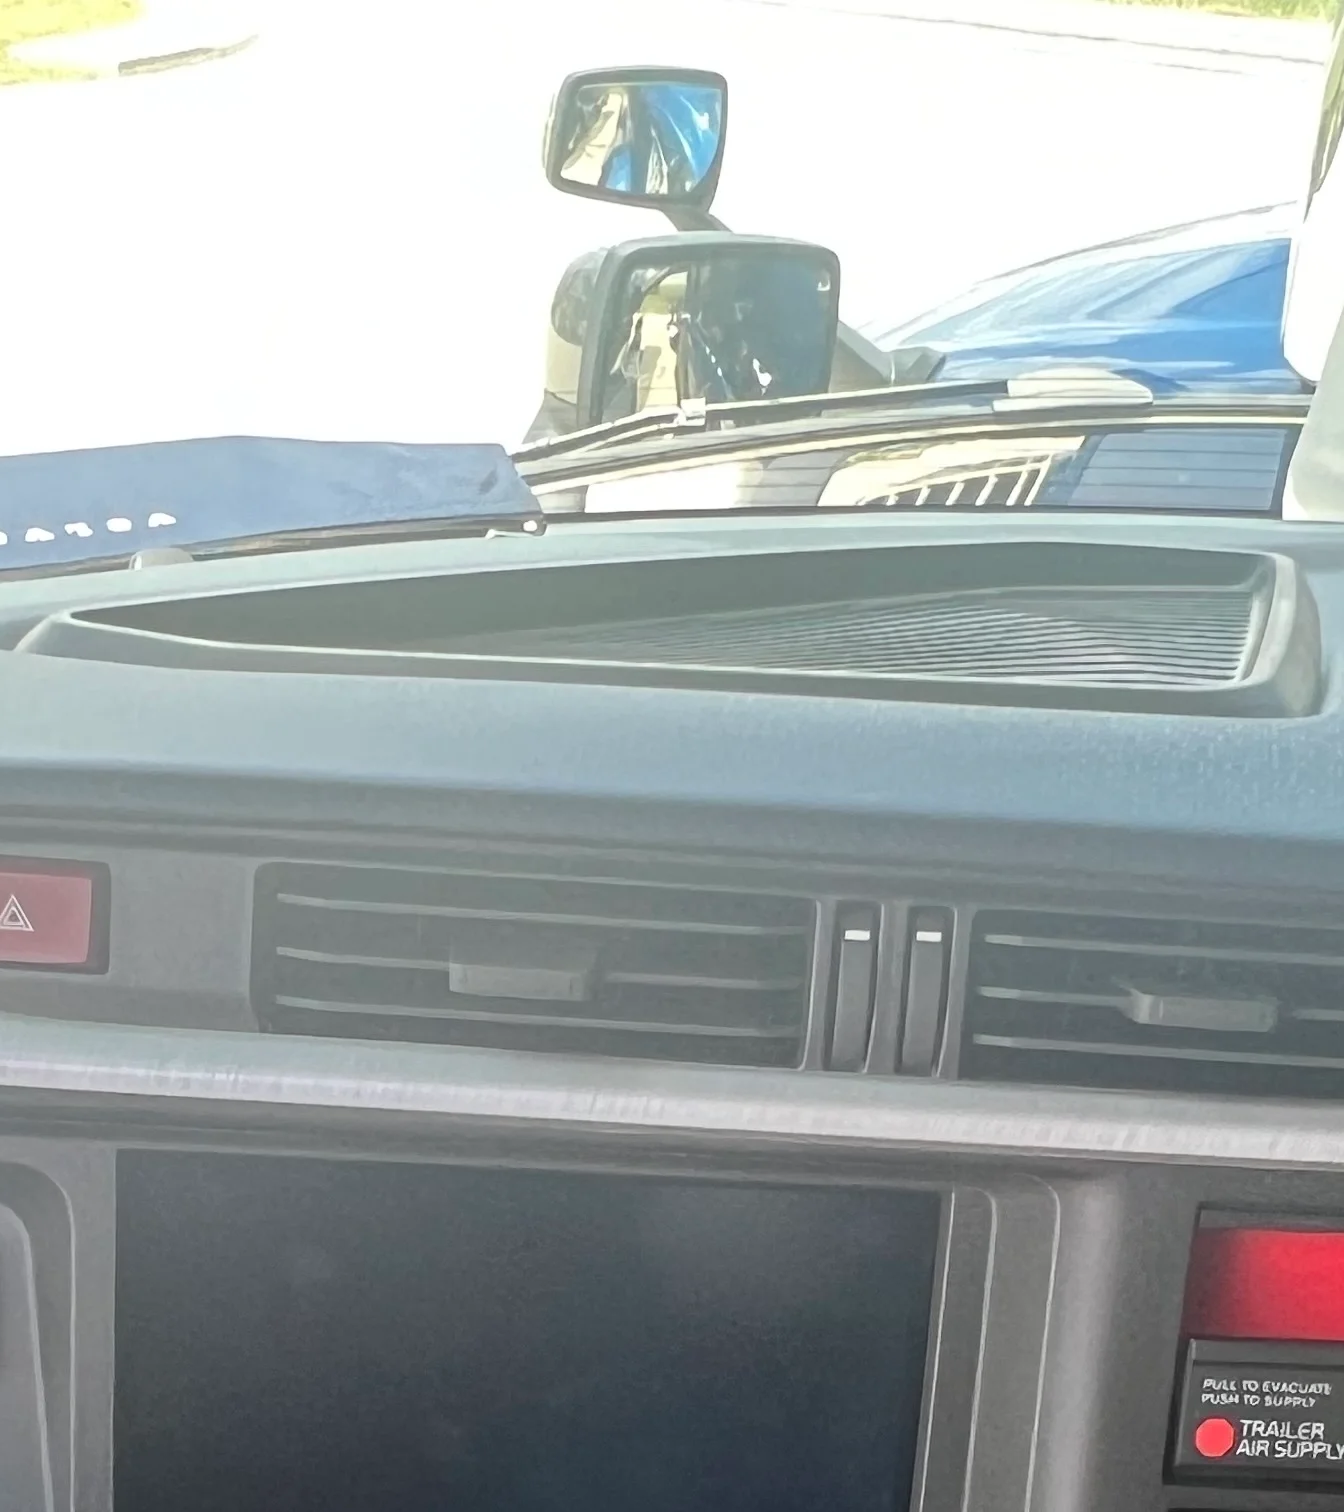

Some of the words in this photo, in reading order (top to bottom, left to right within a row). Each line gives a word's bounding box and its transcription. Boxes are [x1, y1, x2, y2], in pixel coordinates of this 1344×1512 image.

[1202, 1378, 1236, 1391] PULL
[1242, 1380, 1259, 1391] TO
[1262, 1381, 1333, 1395] EVACUATE
[1201, 1394, 1239, 1405] PUSH
[1244, 1394, 1260, 1406] TO
[1264, 1395, 1316, 1407] SUPPLY
[1240, 1419, 1325, 1441] TRAILER
[1236, 1440, 1269, 1457] AIR
